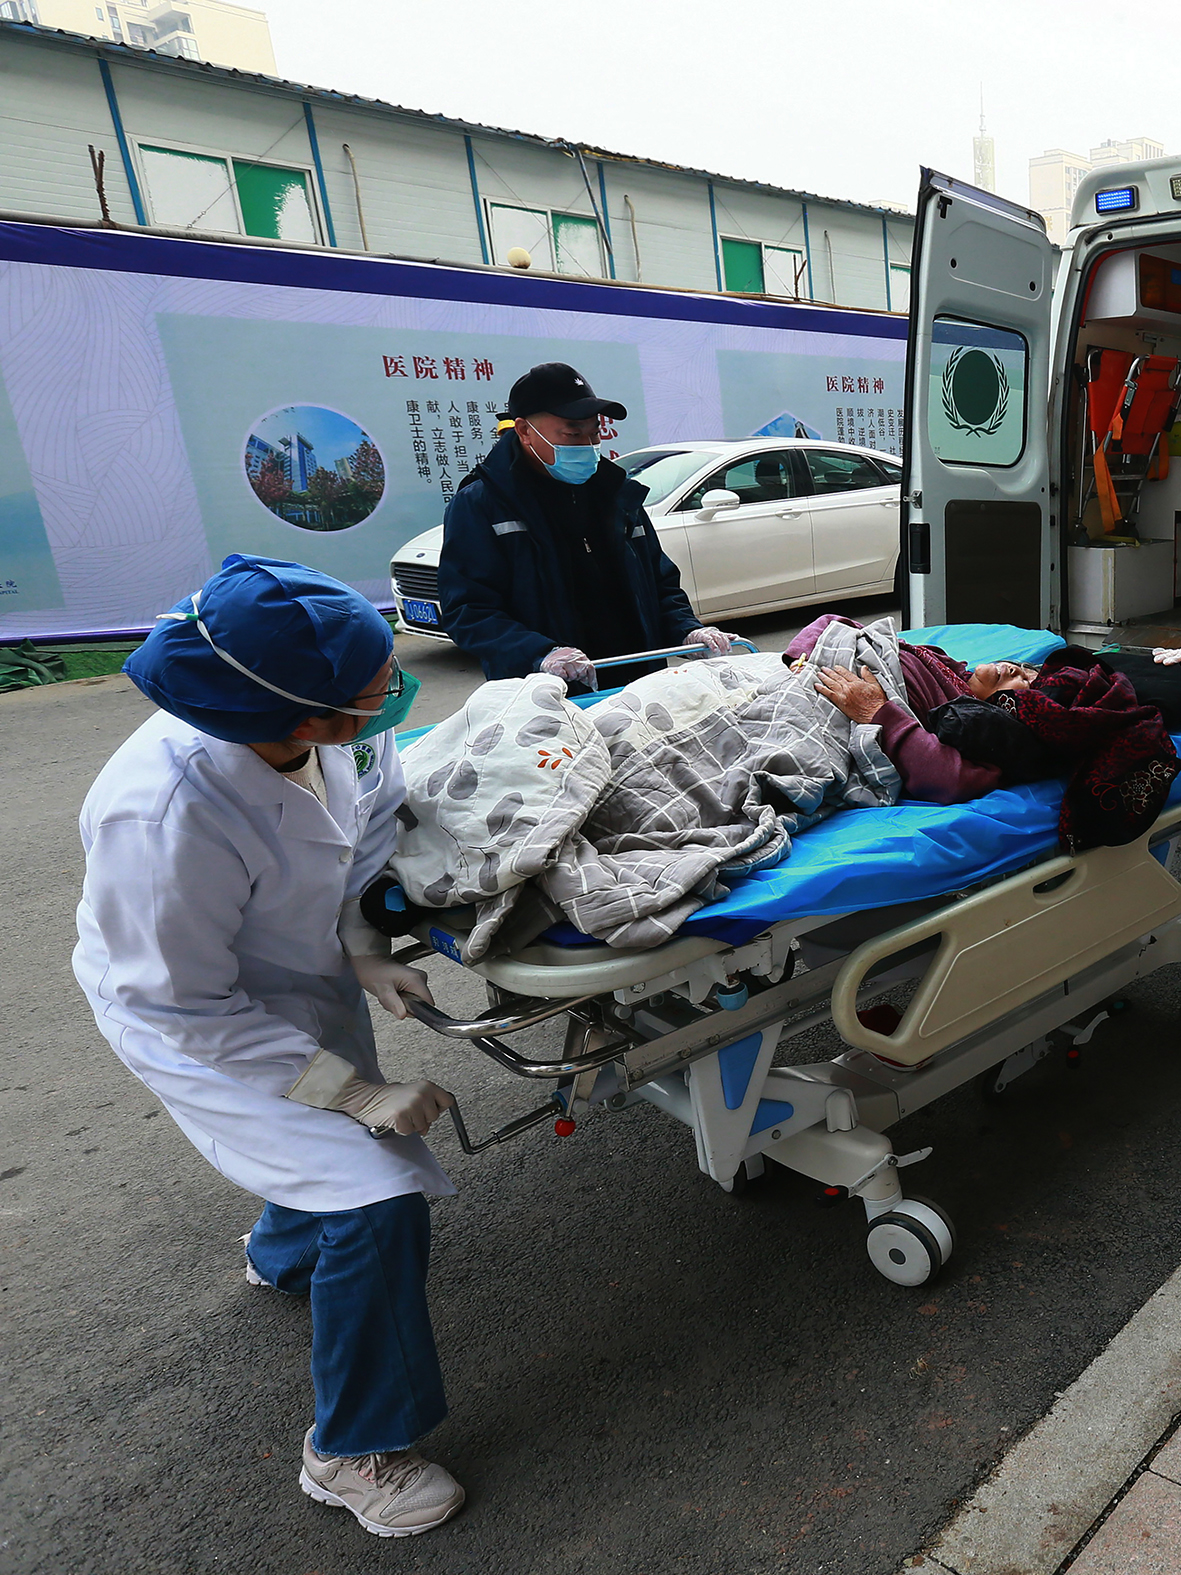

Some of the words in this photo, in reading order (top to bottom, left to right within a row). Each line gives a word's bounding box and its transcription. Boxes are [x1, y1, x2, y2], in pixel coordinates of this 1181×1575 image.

[382, 355, 494, 381] 医院精神
[826, 376, 884, 393] 医院精神
[406, 400, 432, 484] 康卫士的精神。
[448, 401, 469, 473] 人敢于担当
